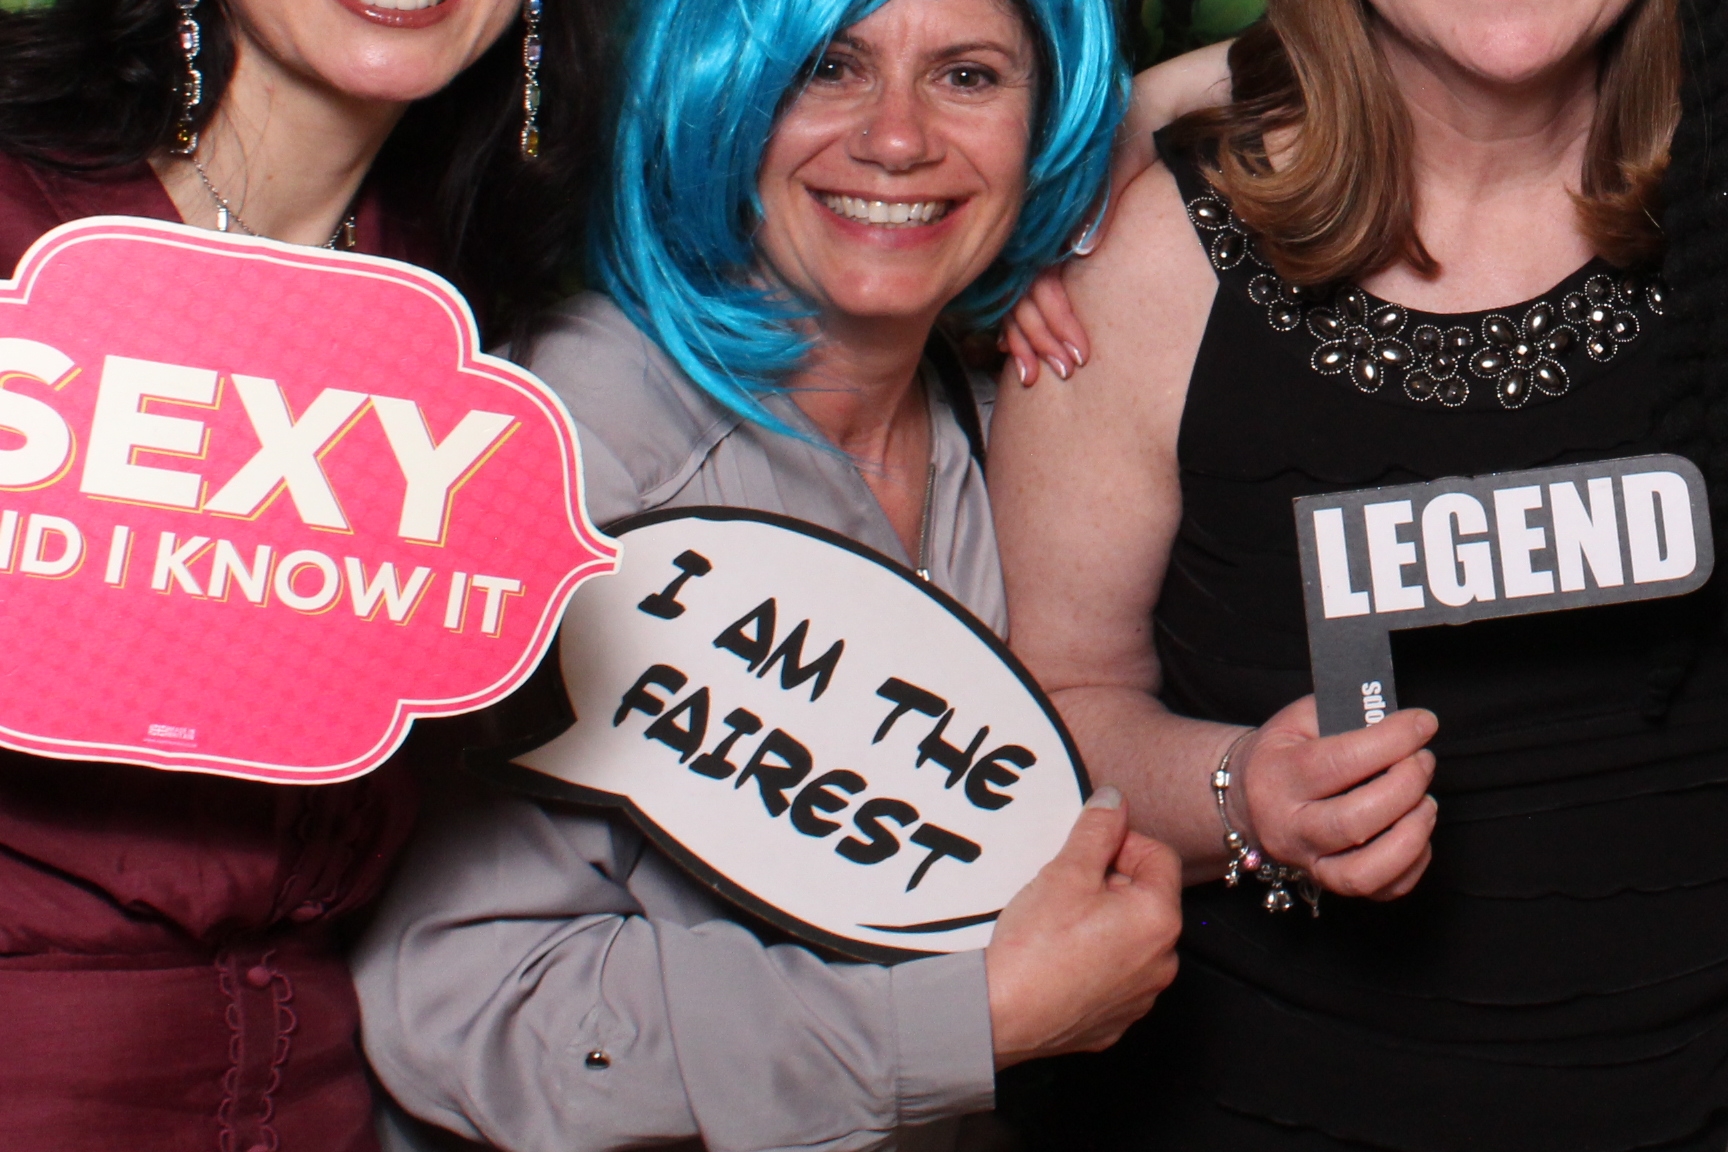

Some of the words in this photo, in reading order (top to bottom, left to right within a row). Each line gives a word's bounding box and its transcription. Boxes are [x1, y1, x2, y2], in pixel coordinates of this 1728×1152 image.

[0, 337, 521, 546] SEXY
[104, 524, 134, 588] I
[151, 531, 435, 626] KNOW
[443, 570, 525, 638] IT
[1313, 470, 1697, 620] LEGEND
[637, 549, 713, 620] I
[712, 597, 845, 703] AM
[871, 676, 1037, 811] THE
[1361, 680, 1386, 727] ops
[612, 664, 982, 893] FAIREST
